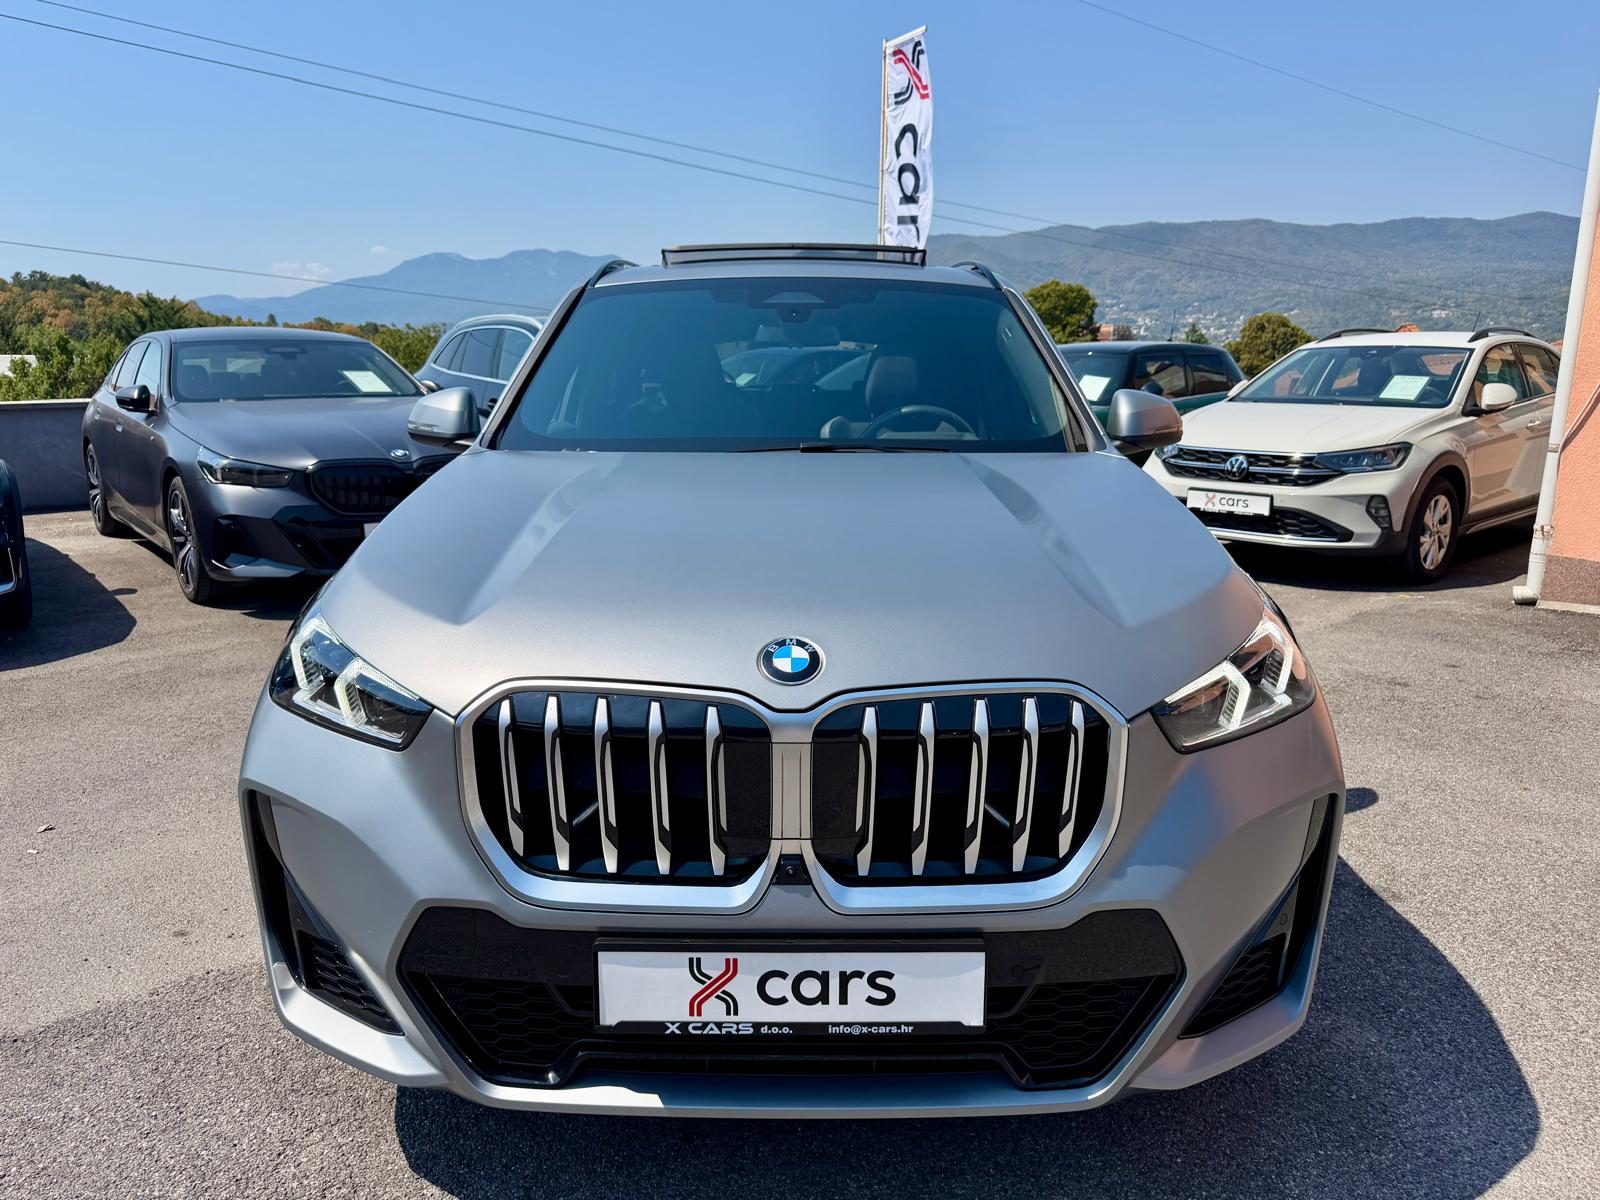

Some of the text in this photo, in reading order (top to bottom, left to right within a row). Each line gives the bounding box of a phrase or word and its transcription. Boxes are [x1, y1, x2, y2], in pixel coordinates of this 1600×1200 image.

[895, 123, 921, 262] car
[1219, 496, 1249, 508] cars
[767, 638, 817, 653] BMW
[756, 969, 896, 1006] cars
[664, 1022, 914, 1035] X CARS d.o.o. info@x-cars.hr
